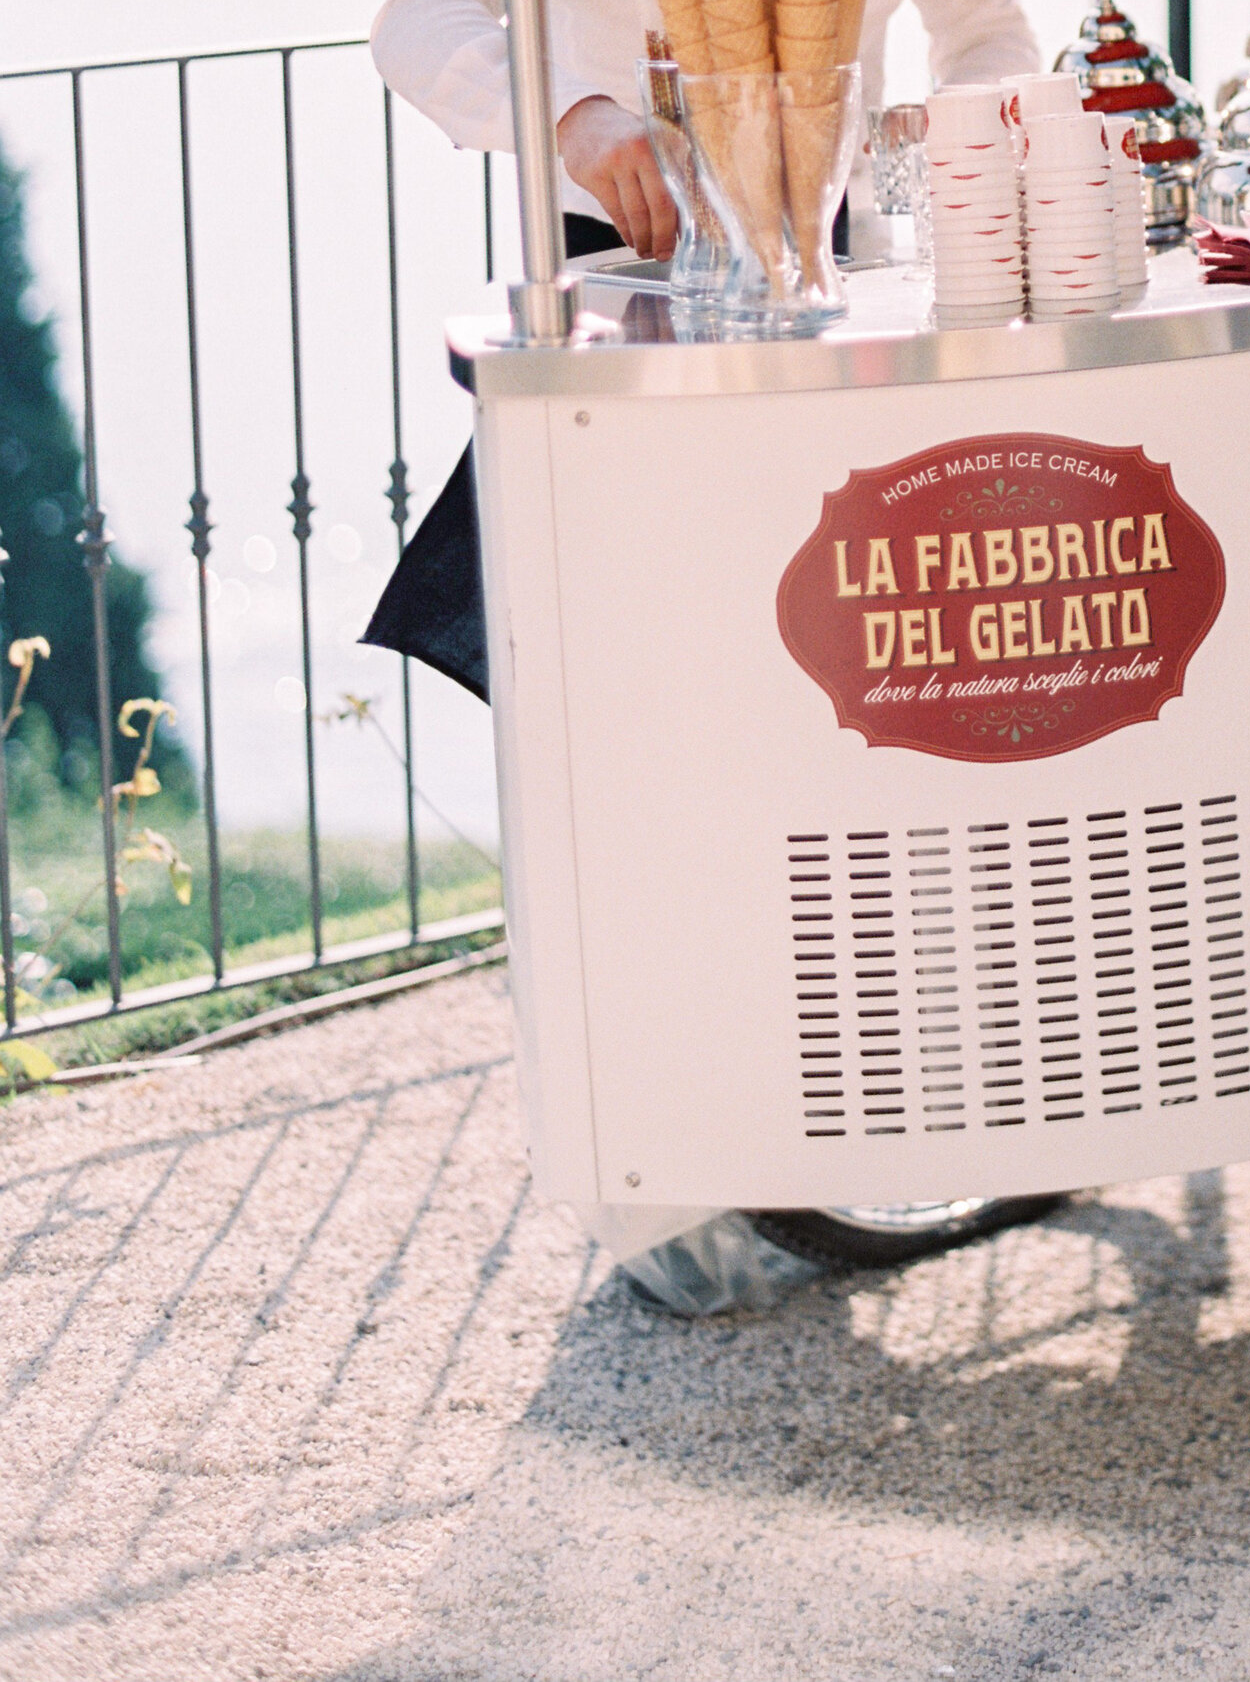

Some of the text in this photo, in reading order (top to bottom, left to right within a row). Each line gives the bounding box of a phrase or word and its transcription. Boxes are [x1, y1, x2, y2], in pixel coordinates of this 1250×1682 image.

[881, 452, 1119, 505] HOME MADE ICE CREAM
[833, 512, 1174, 597] LA FABBRICA
[862, 587, 1152, 670] DEL GELATO
[864, 652, 1164, 703] dove la natura sceglie i colori
